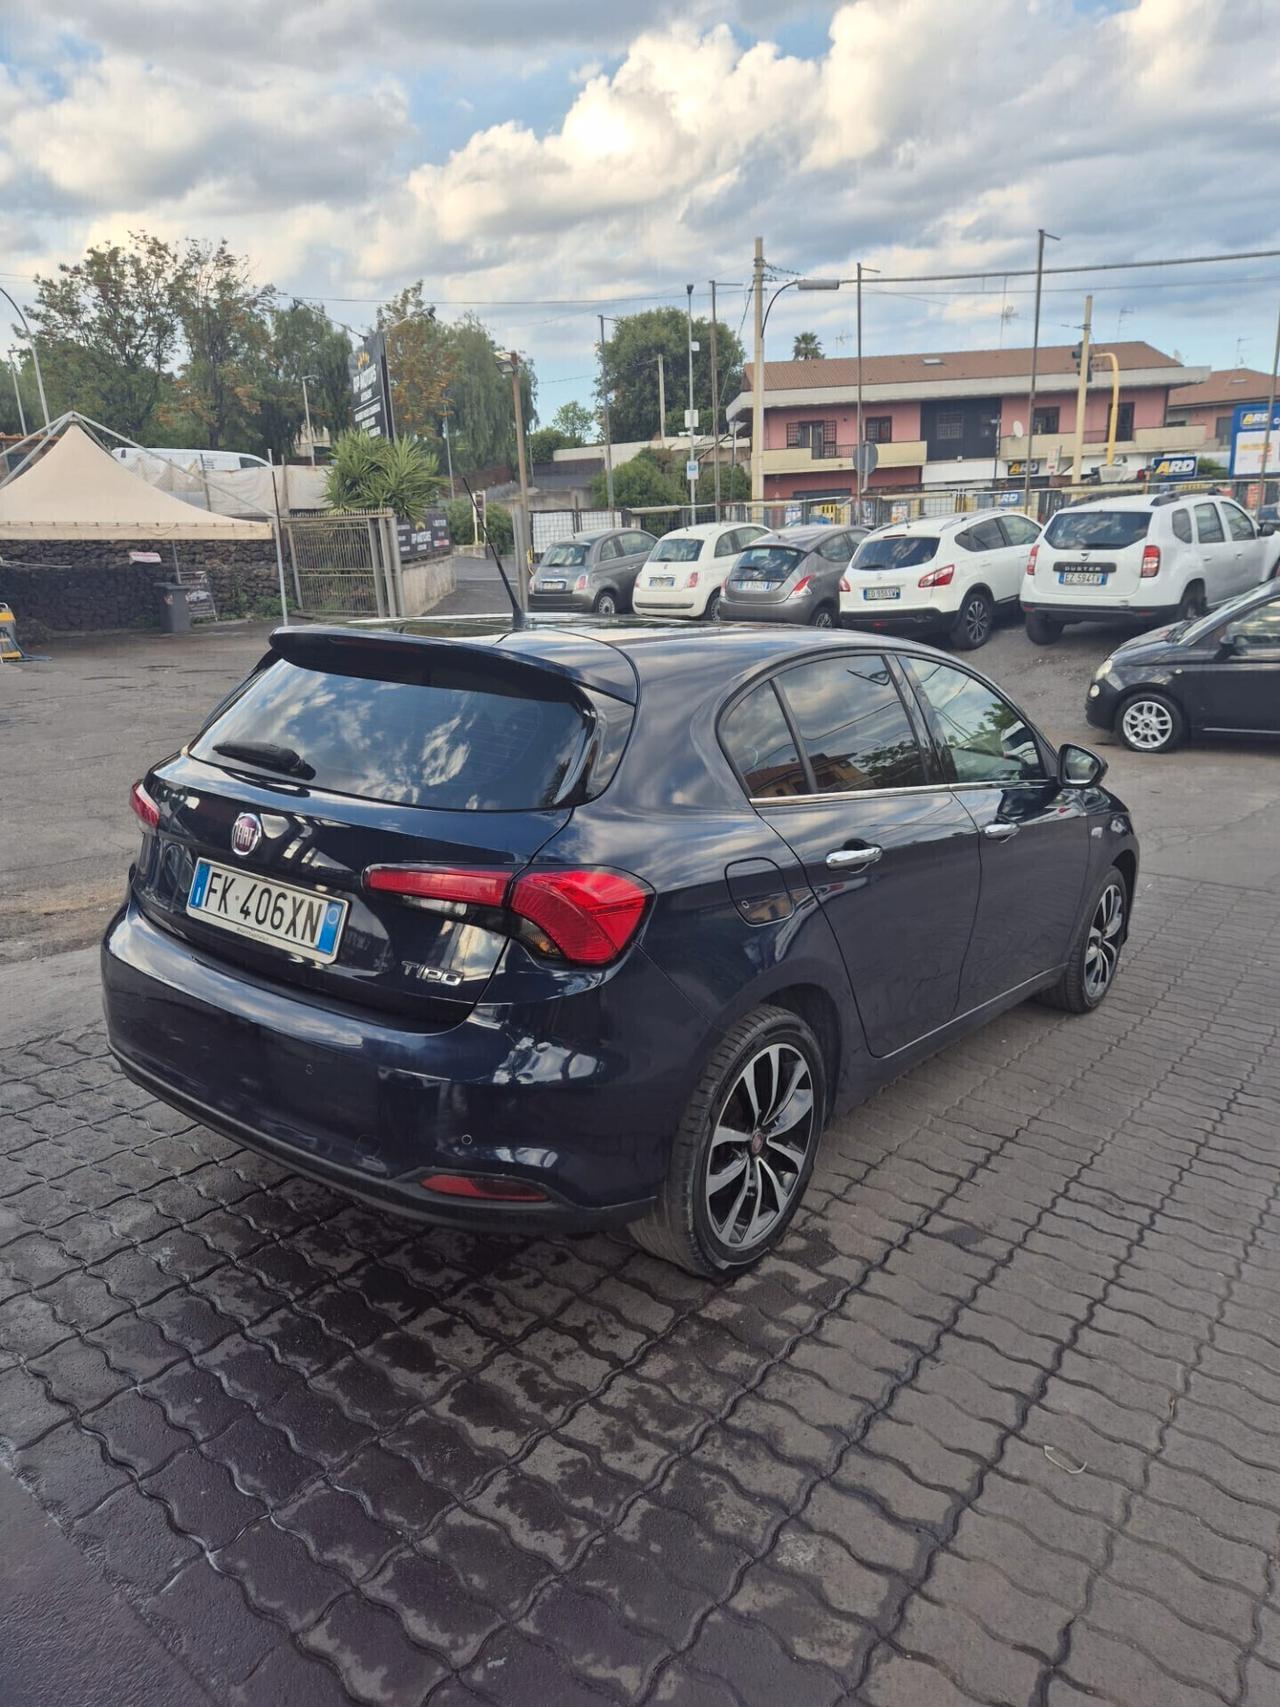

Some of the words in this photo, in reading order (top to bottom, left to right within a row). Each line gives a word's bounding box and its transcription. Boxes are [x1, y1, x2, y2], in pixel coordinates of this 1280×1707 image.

[1009, 463, 1039, 475] ARD
[1155, 459, 1196, 476] ARD
[236, 823, 256, 847] FIAT
[204, 871, 236, 914] FK
[239, 883, 323, 943] 406XN
[401, 961, 464, 987] TIPO
